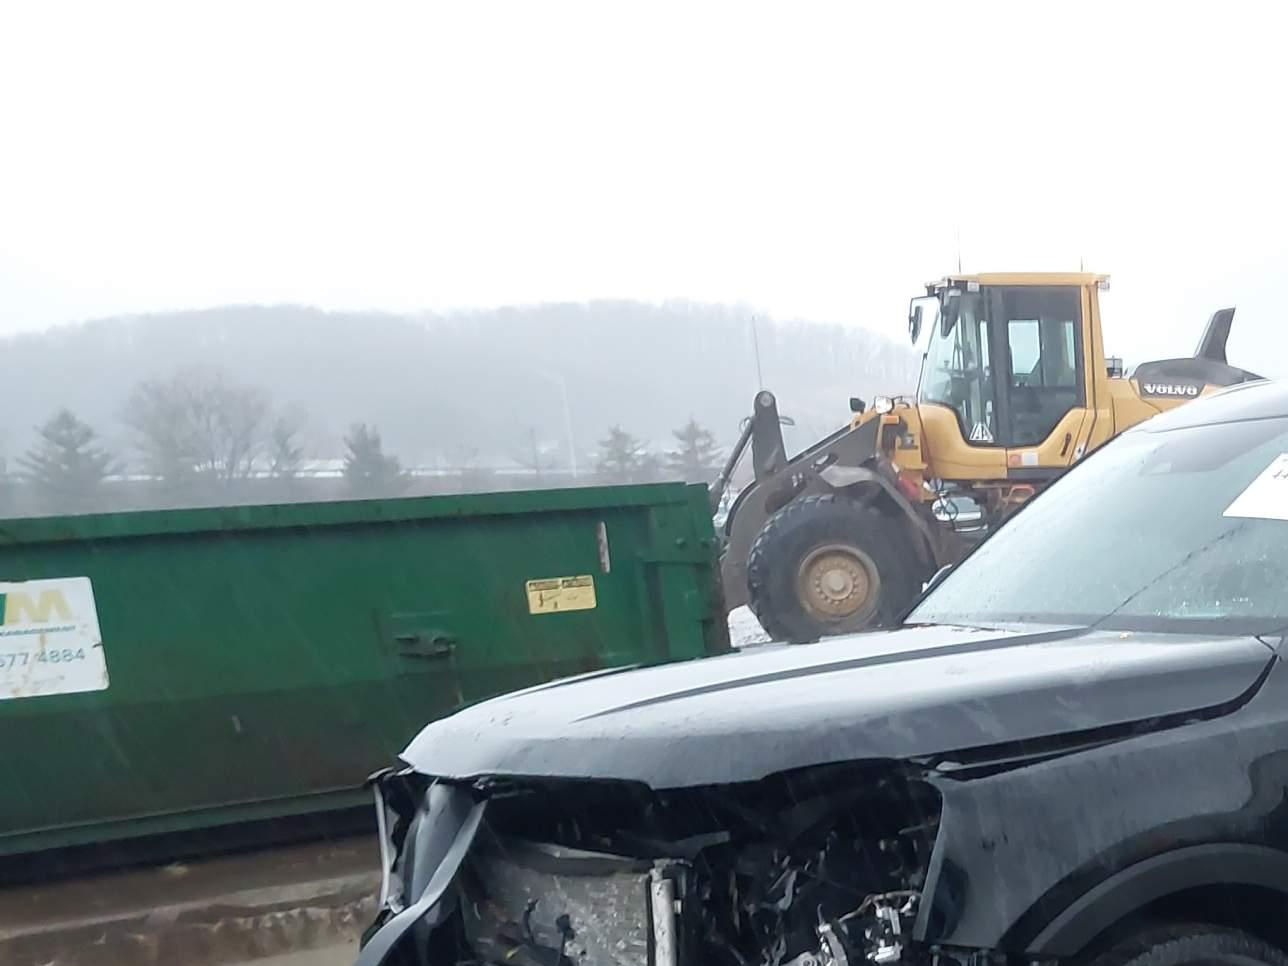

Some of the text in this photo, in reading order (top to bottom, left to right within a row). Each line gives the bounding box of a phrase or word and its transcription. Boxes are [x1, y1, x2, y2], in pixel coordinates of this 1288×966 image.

[1143, 383, 1198, 396] VOLVO
[0, 588, 73, 626] M
[35, 647, 86, 663] 4884
